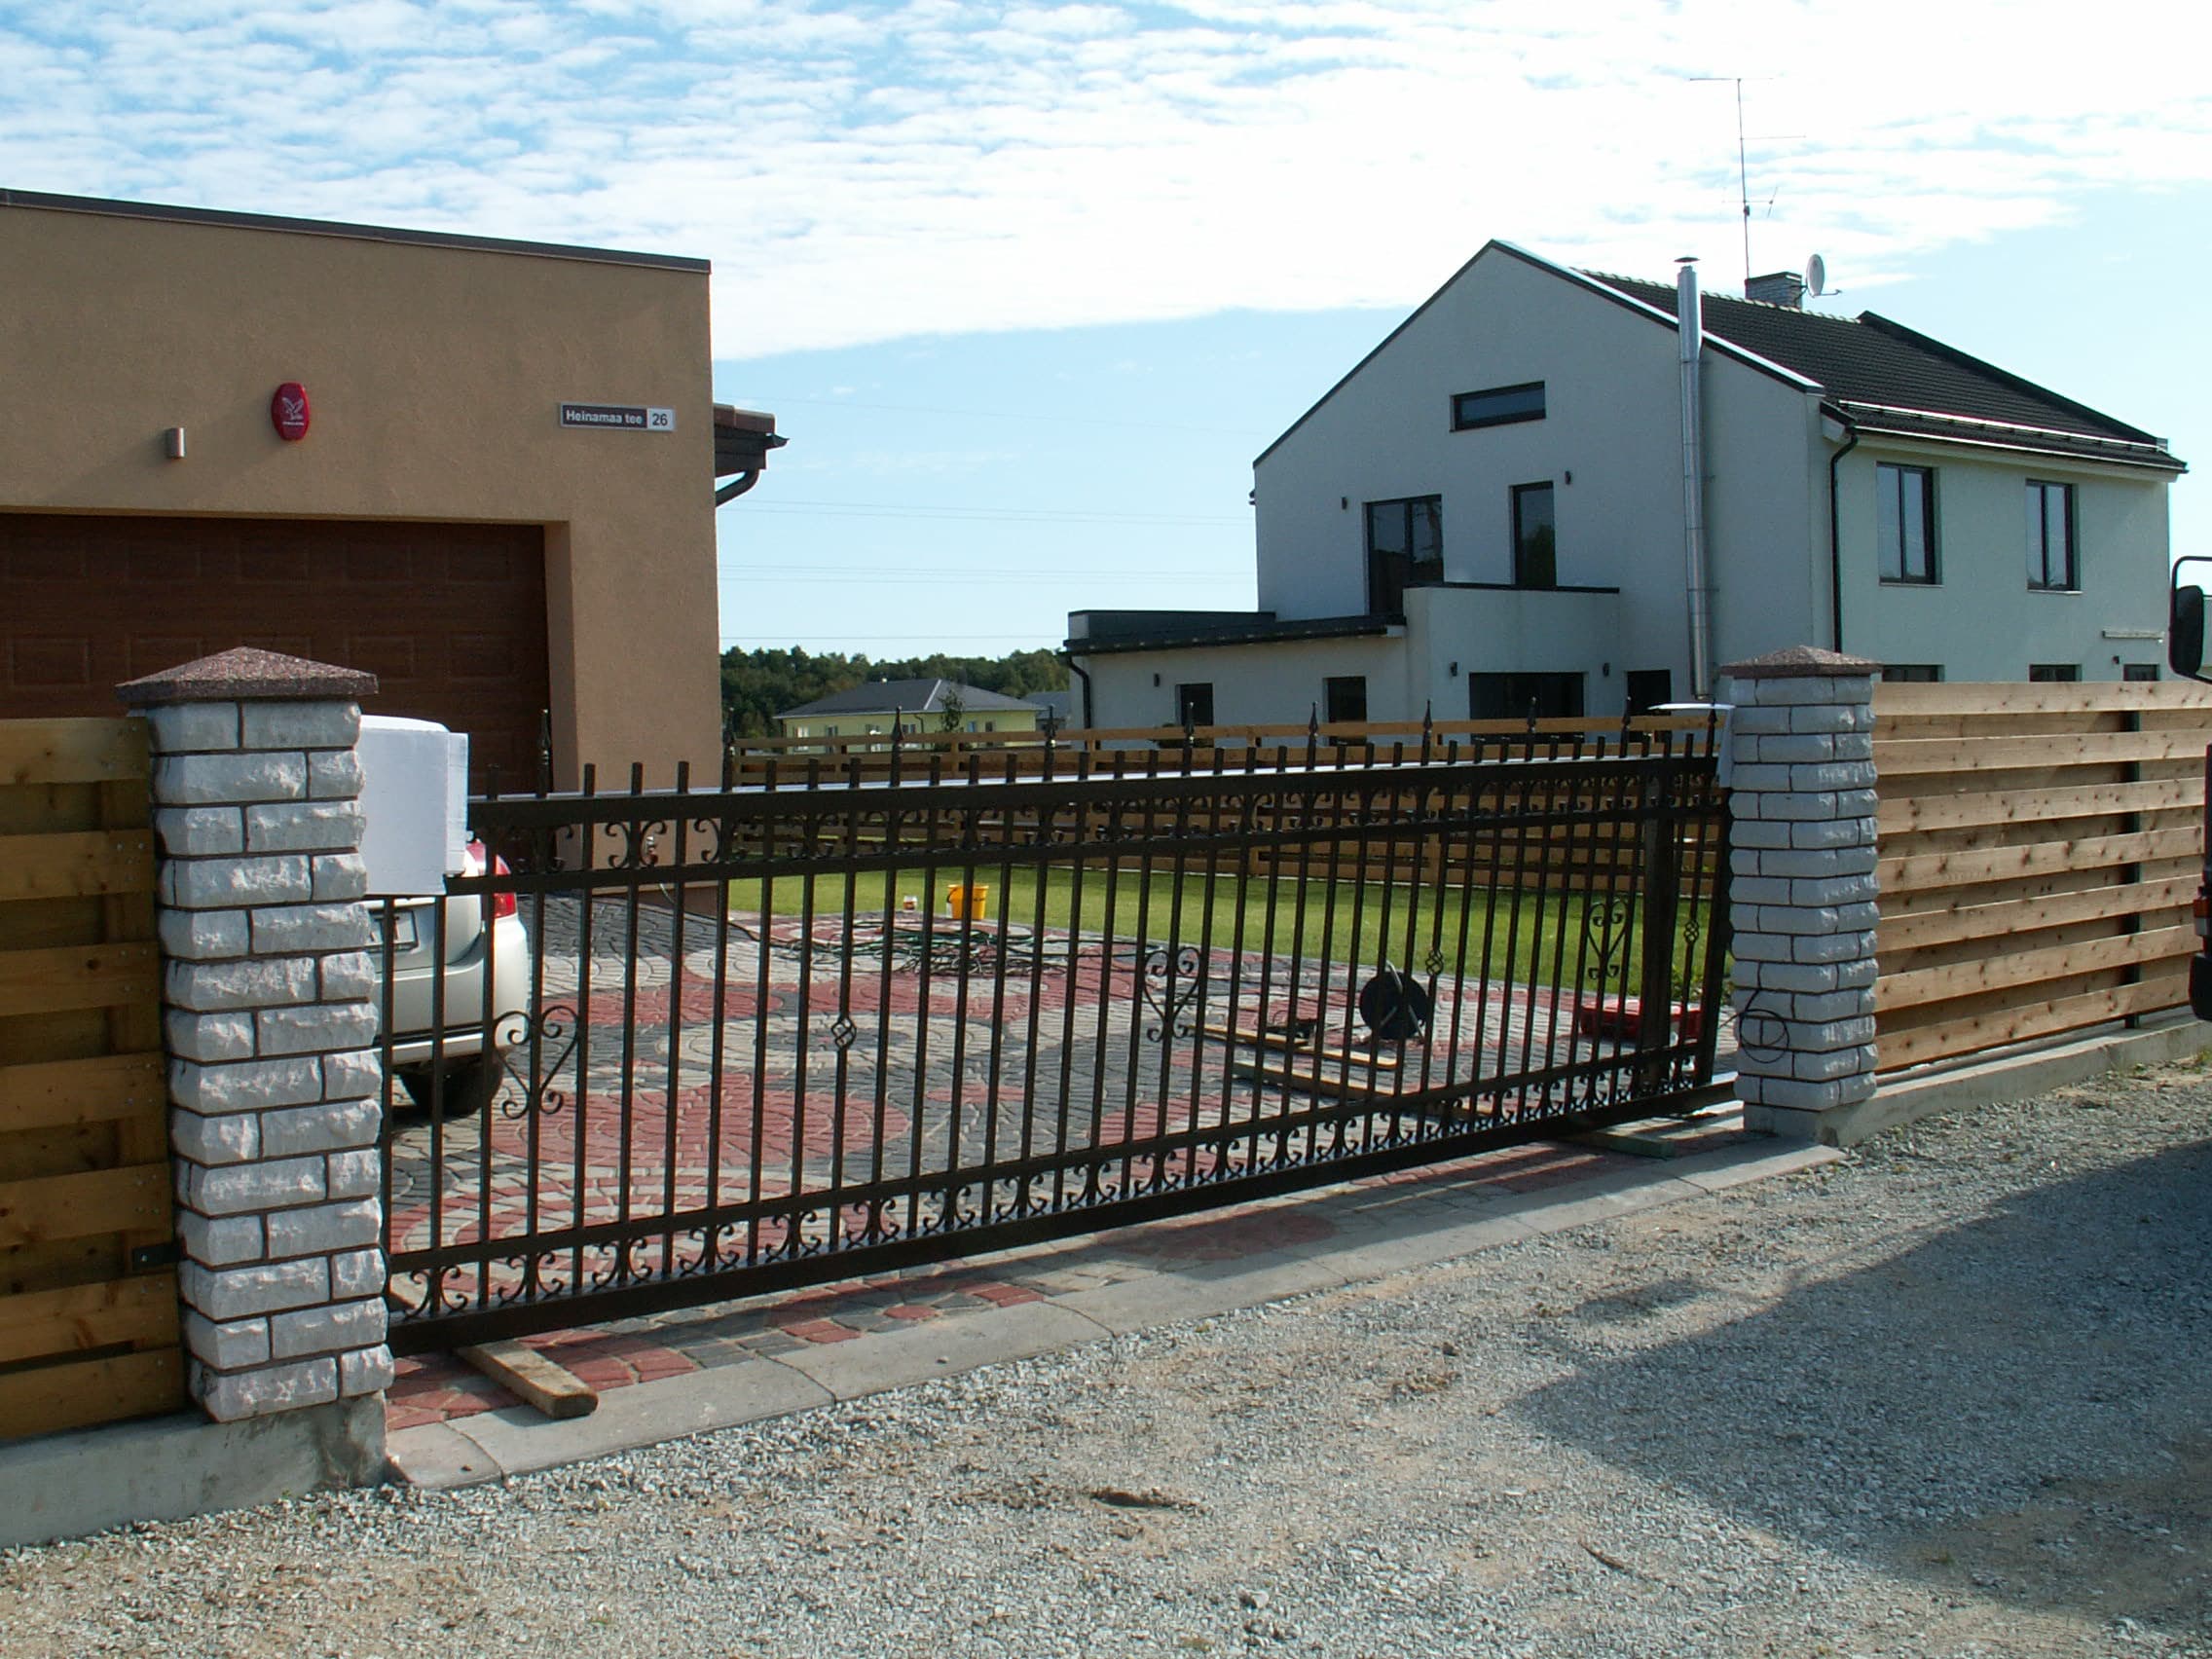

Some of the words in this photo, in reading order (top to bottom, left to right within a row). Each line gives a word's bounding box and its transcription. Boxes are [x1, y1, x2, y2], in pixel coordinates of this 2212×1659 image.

[566, 409, 622, 424] Heinamaa
[624, 413, 644, 424] tee
[652, 413, 668, 426] 26
